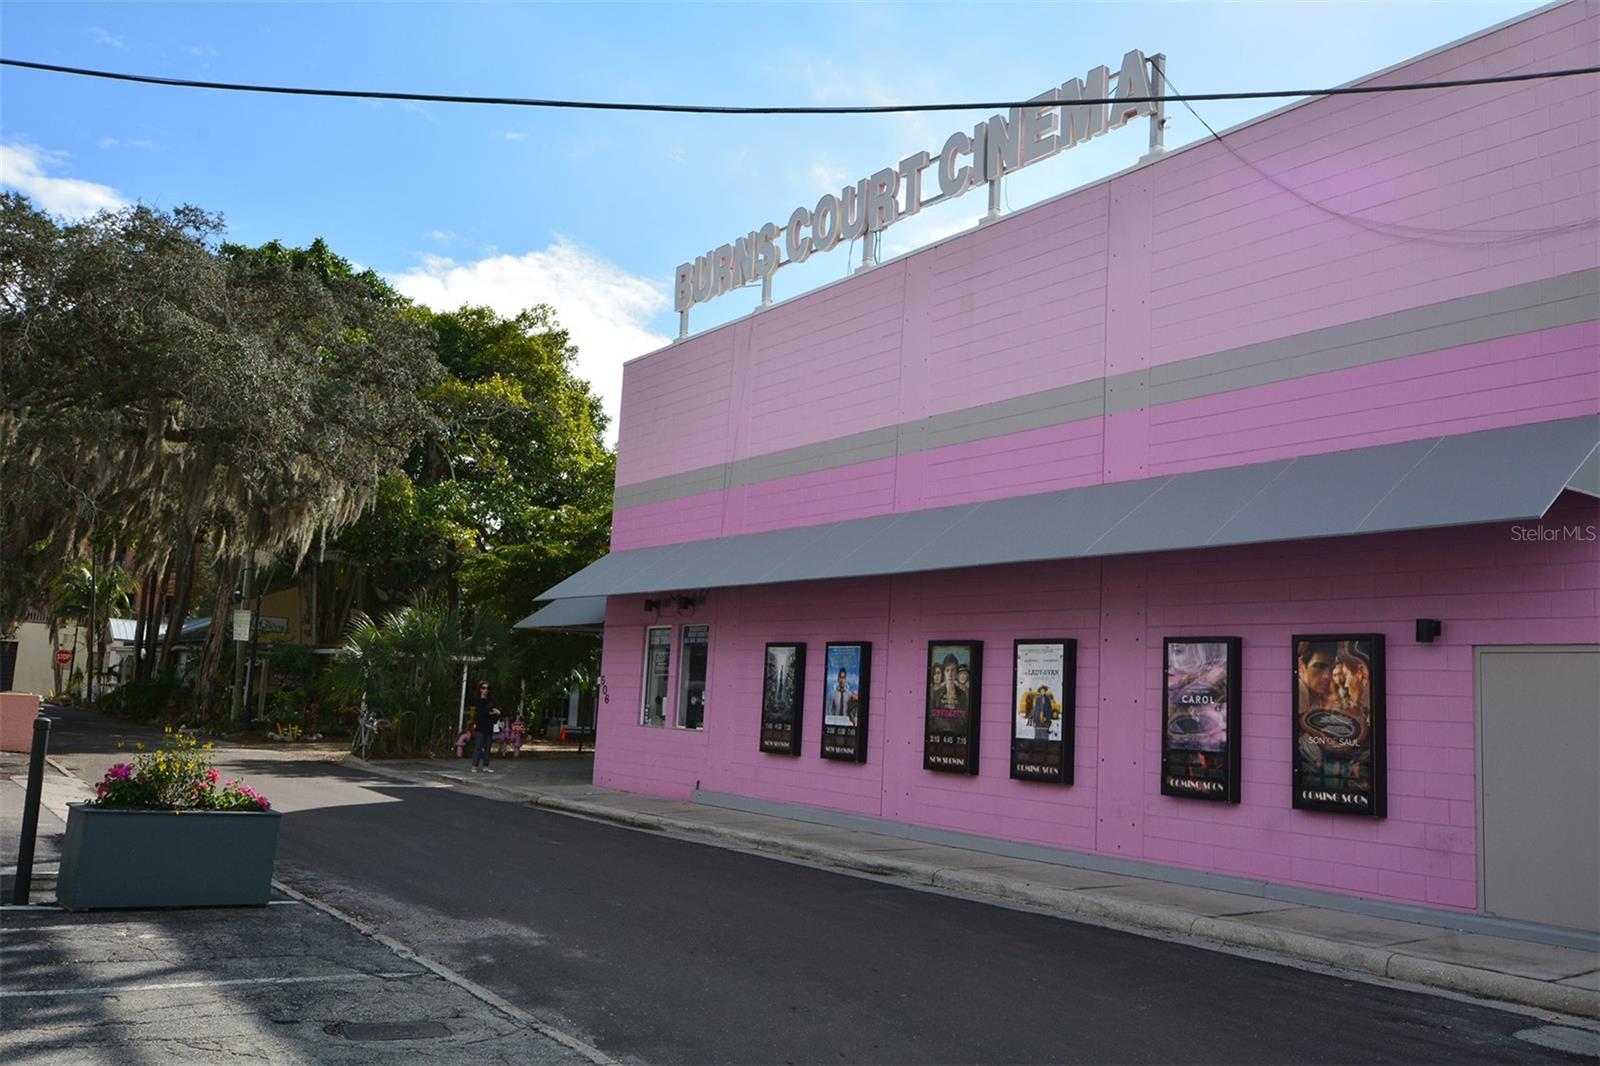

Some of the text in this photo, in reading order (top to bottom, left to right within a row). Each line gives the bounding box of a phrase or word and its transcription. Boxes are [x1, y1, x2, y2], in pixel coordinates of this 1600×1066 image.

[675, 48, 1157, 312] BURNS COURT CINEMA
[600, 675, 610, 704] 506
[1182, 695, 1215, 705] CAROL
[1308, 736, 1326, 745] SON
[1338, 738, 1361, 747] SAUL
[1169, 778, 1224, 792] COMING SOON
[1302, 790, 1369, 804] COMING SOON
